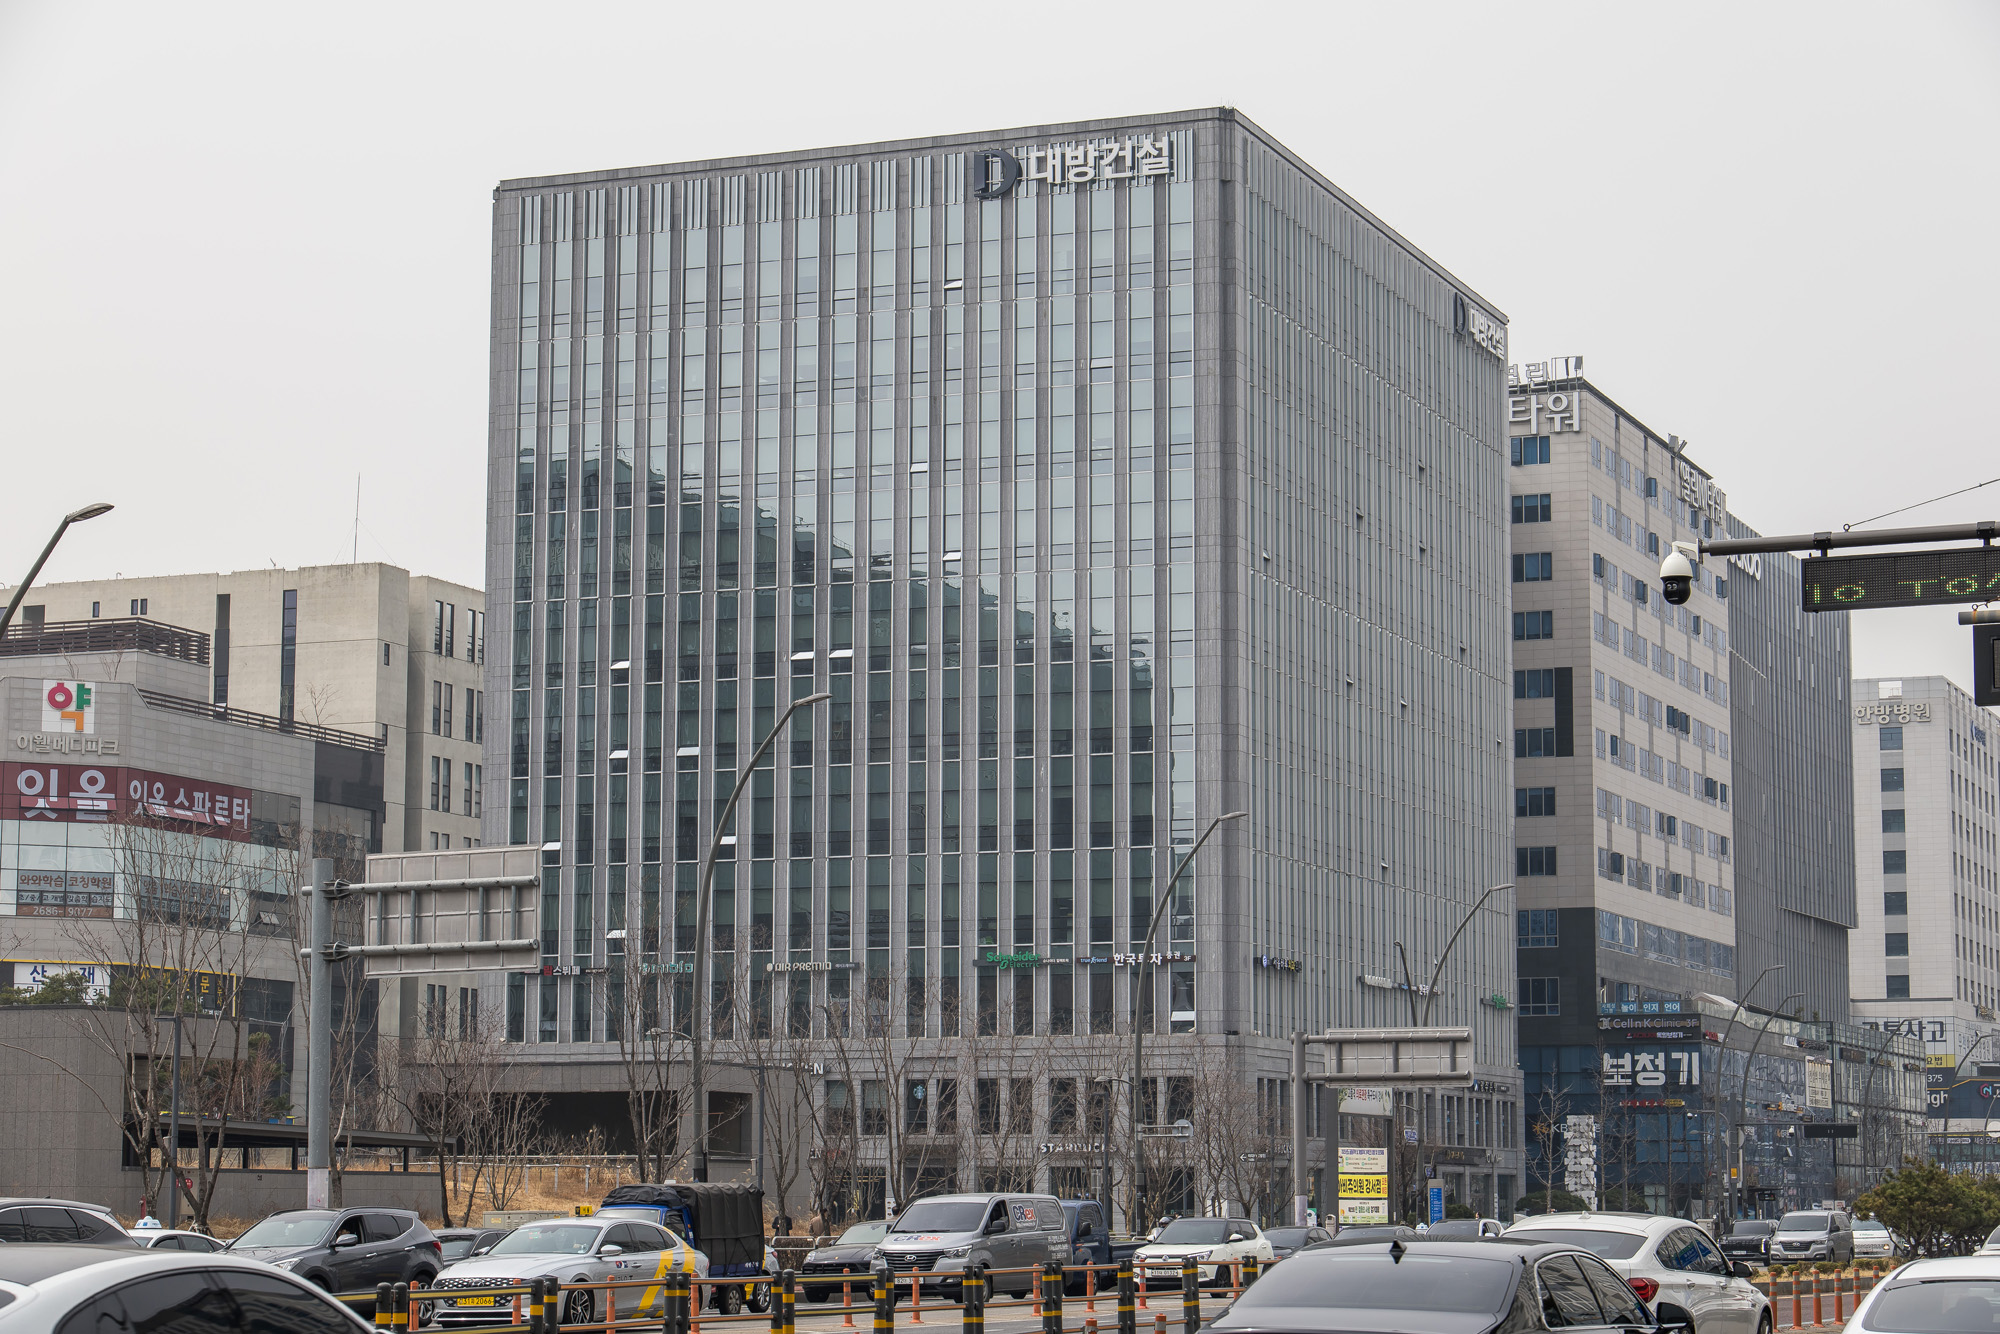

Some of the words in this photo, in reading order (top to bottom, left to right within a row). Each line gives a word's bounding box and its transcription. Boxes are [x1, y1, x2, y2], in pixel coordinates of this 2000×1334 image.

[1030, 136, 1171, 184] 대방건설
[1469, 306, 1504, 361] 대방건설
[1508, 391, 1581, 435] 타워
[48, 682, 92, 731] 약
[1855, 703, 1931, 725] 한방병원
[16, 768, 116, 821] 잇올
[174, 788, 251, 830] 스파르타
[20, 874, 65, 888] 와와학습
[68, 876, 112, 889] 코칭학원
[986, 952, 1041, 962] Schneider
[1621, 1003, 1637, 1012] 놀이
[1643, 1003, 1659, 1012] 인지
[1664, 1002, 1680, 1012] 언어
[1653, 1018, 1681, 1028] Clinic
[1685, 1019, 1698, 1028] 3F
[1603, 1052, 1700, 1086] 보청기
